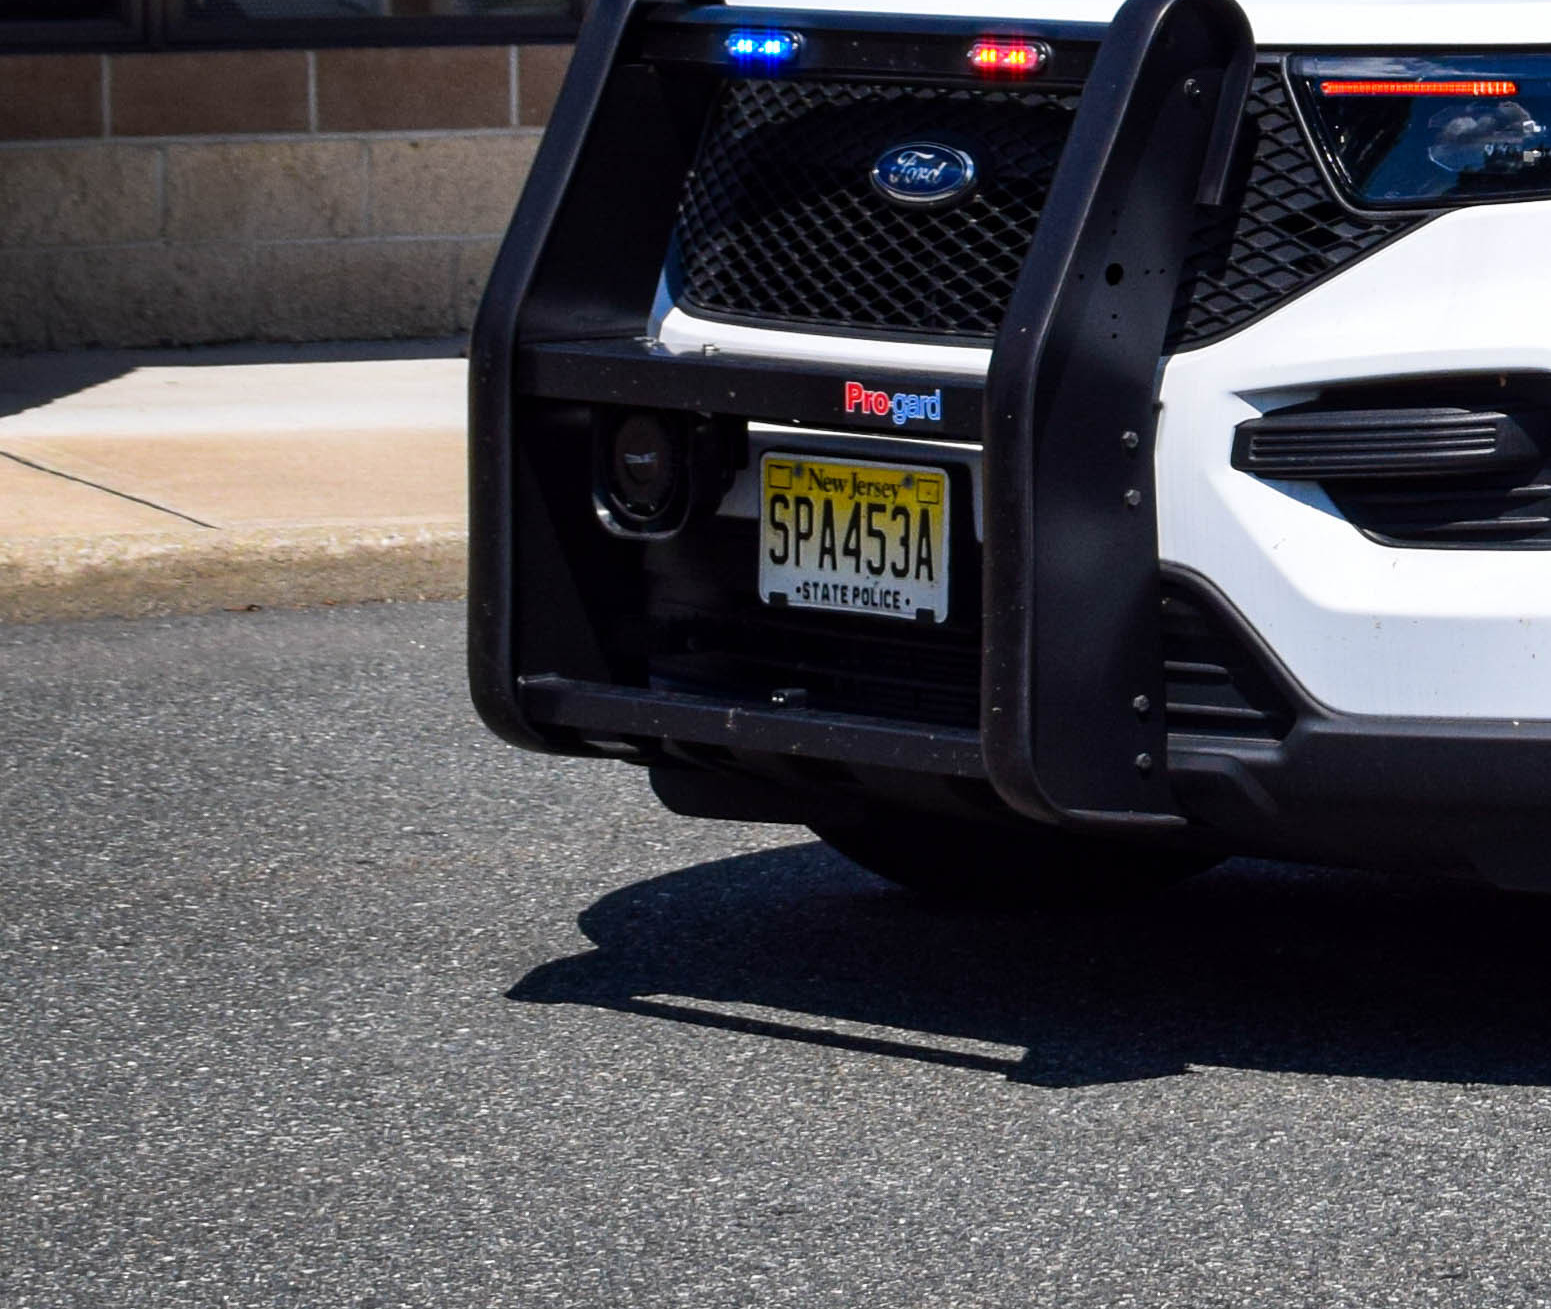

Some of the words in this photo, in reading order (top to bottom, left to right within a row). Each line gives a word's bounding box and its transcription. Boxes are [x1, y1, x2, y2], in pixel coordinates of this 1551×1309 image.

[888, 150, 948, 185] Ford
[845, 381, 942, 425] Pro-gard
[808, 467, 848, 493] New
[848, 471, 902, 502] Jersey
[768, 494, 935, 582] SPA453A
[802, 582, 848, 605] STATE
[852, 586, 901, 609] POLICE
